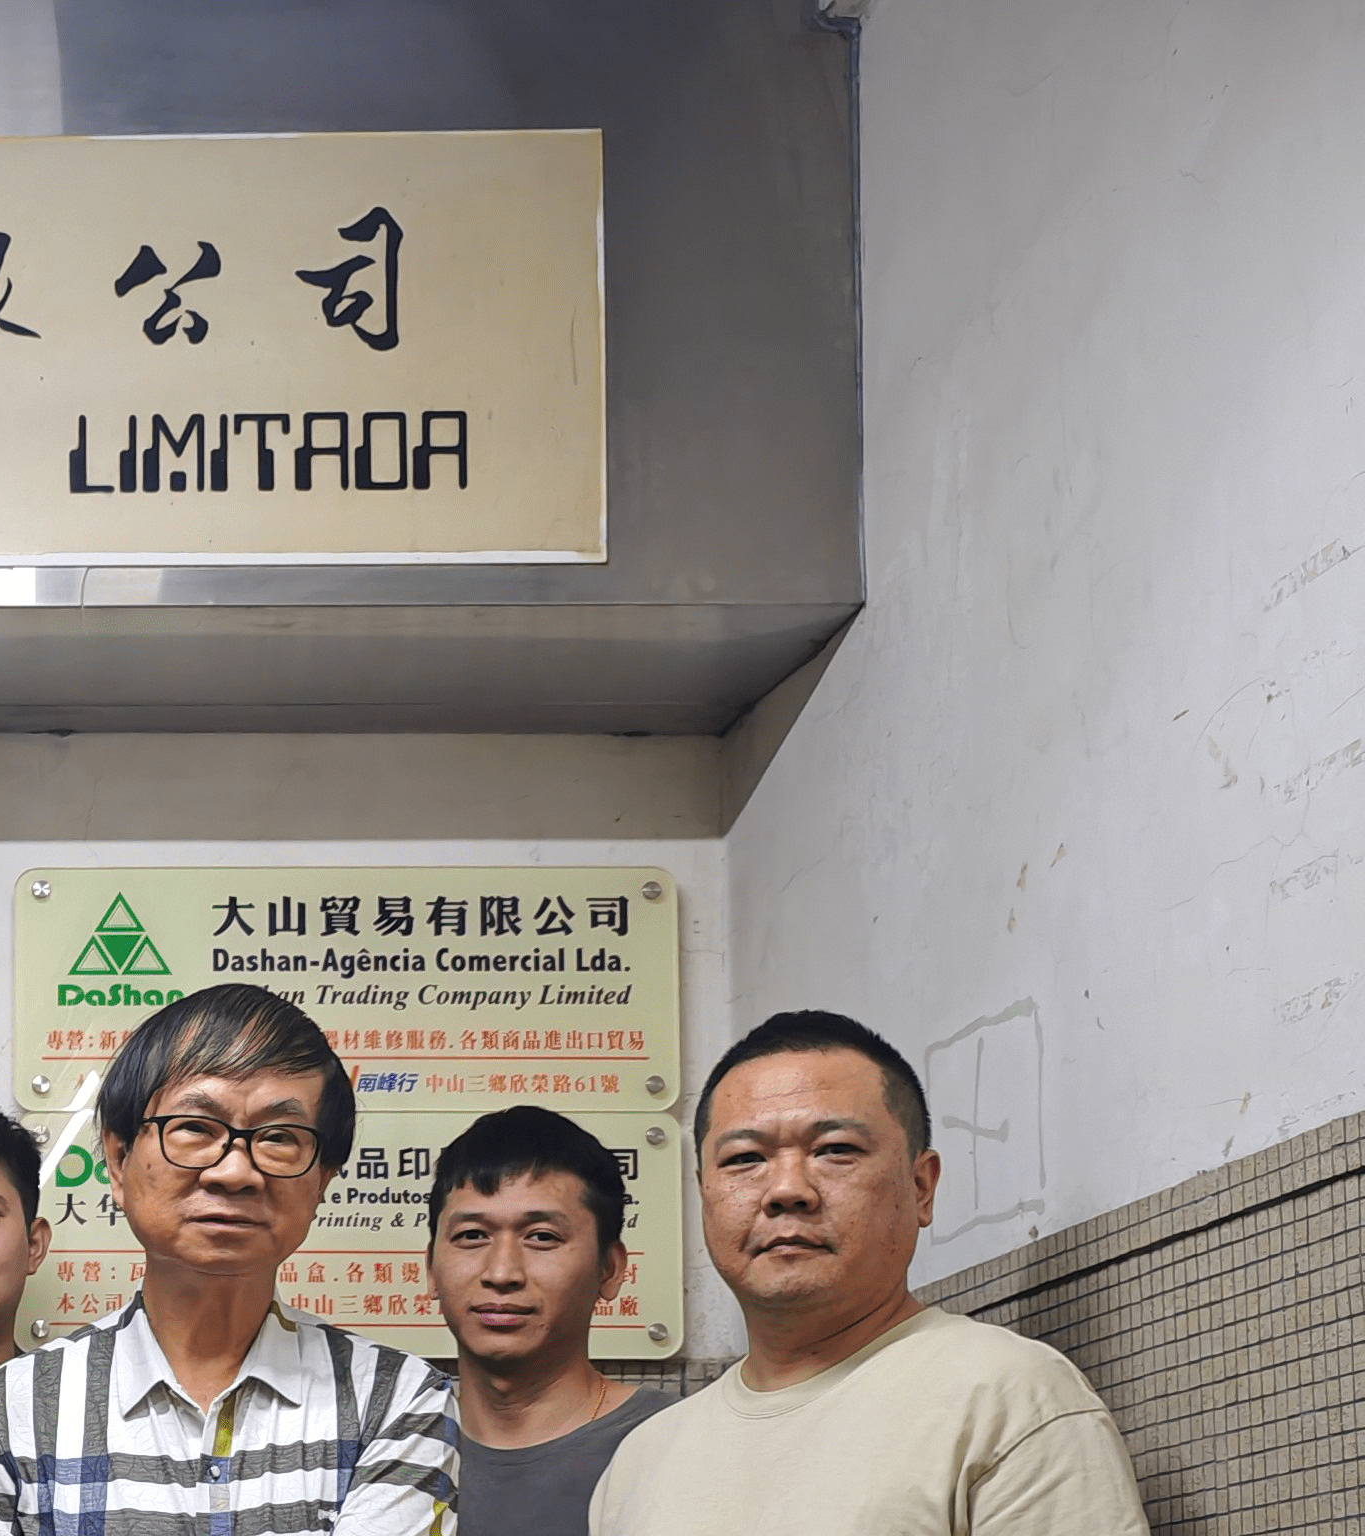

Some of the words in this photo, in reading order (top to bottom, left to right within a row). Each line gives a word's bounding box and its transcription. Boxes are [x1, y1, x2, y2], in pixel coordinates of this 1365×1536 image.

[69, 411, 468, 494] LIMITADA
[212, 896, 630, 937] 大山貿易有限公司
[212, 947, 426, 979] Dashan-Agência
[435, 947, 566, 972] Comercial
[575, 948, 631, 972] Lda.
[315, 984, 410, 1010] Trading
[418, 984, 532, 1010] Company
[537, 984, 632, 1006] Limited
[356, 1072, 419, 1093] 南峰行
[347, 1187, 432, 1204] Produtos
[316, 1212, 383, 1231] rinting
[390, 1212, 405, 1227] &
[291, 1293, 444, 1316] 中山三鄉欣榮
